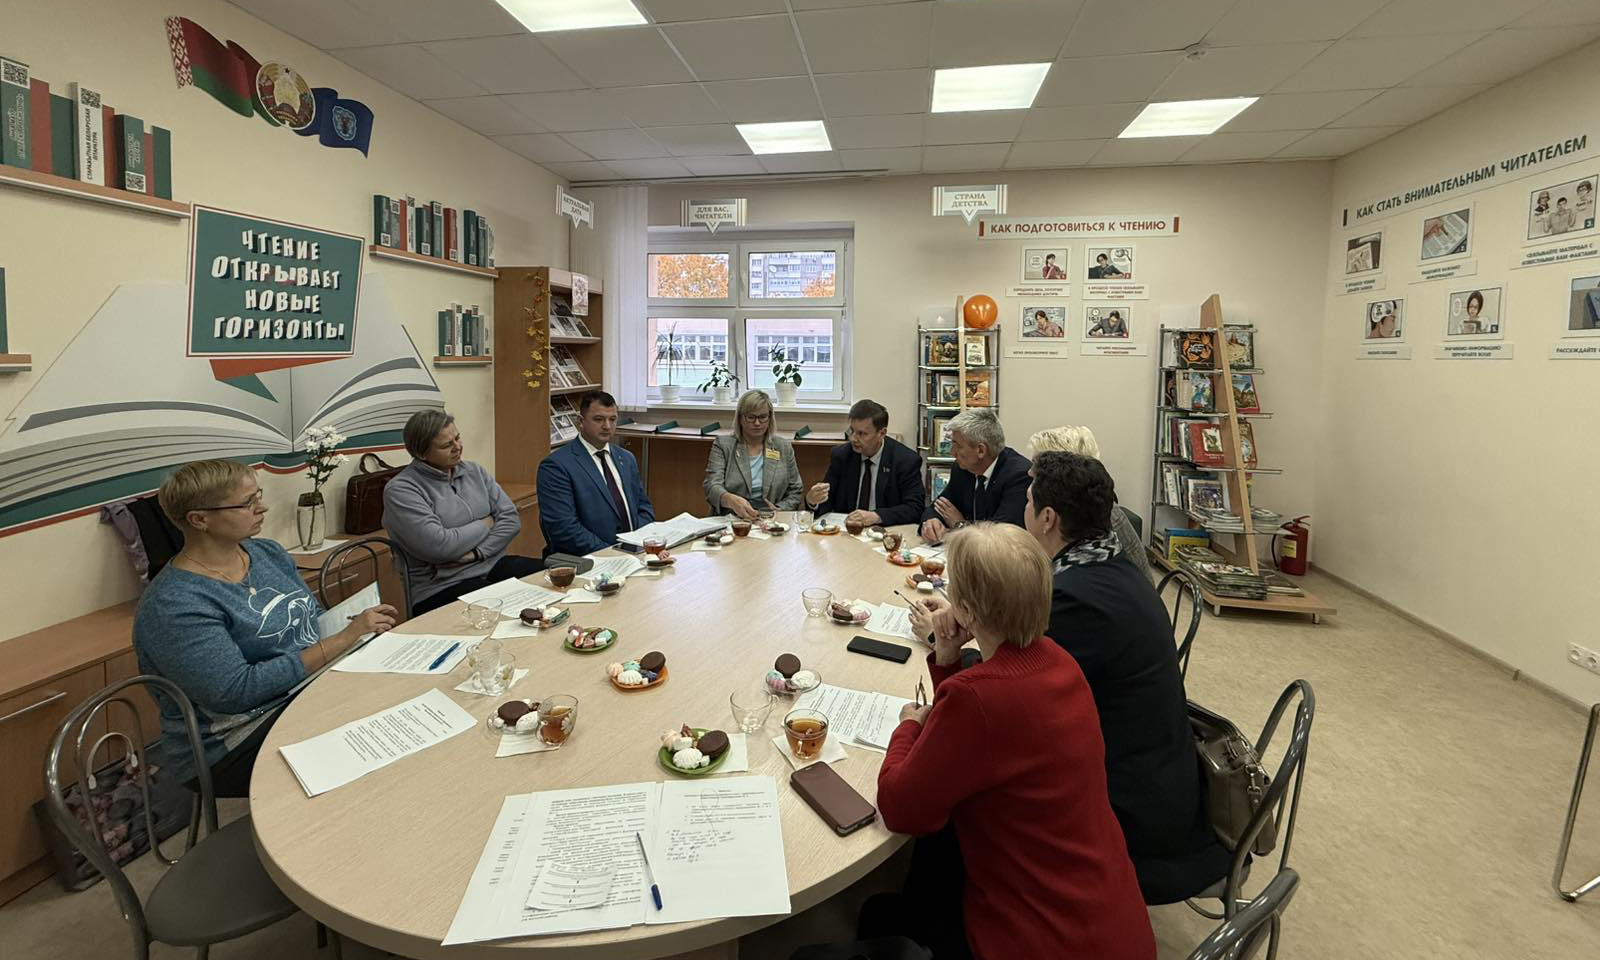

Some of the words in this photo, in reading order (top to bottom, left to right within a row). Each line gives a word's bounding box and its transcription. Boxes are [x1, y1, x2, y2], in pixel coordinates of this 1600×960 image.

[1356, 205, 1374, 219] КАК
[1376, 197, 1402, 212] СТАТЬ
[1404, 165, 1496, 204] ВНИМАТЕЛЬНЫМ
[1500, 135, 1587, 173] ЧИТАТЕЛЕМ
[952, 200, 988, 208] ДЕТСТВА
[991, 223, 1011, 233] КАК
[1015, 222, 1105, 234] ПОДГОТОВИТЬСЯ
[1108, 222, 1116, 231] К
[1120, 220, 1166, 231] ЧТЕНИЮ
[241, 230, 320, 261] ЧТЕНИЕ
[211, 255, 341, 290] ОТКРЫВАЕТ
[245, 289, 322, 313] НОВЫЕ
[213, 316, 345, 340] ГОРИЗОНТЫ
